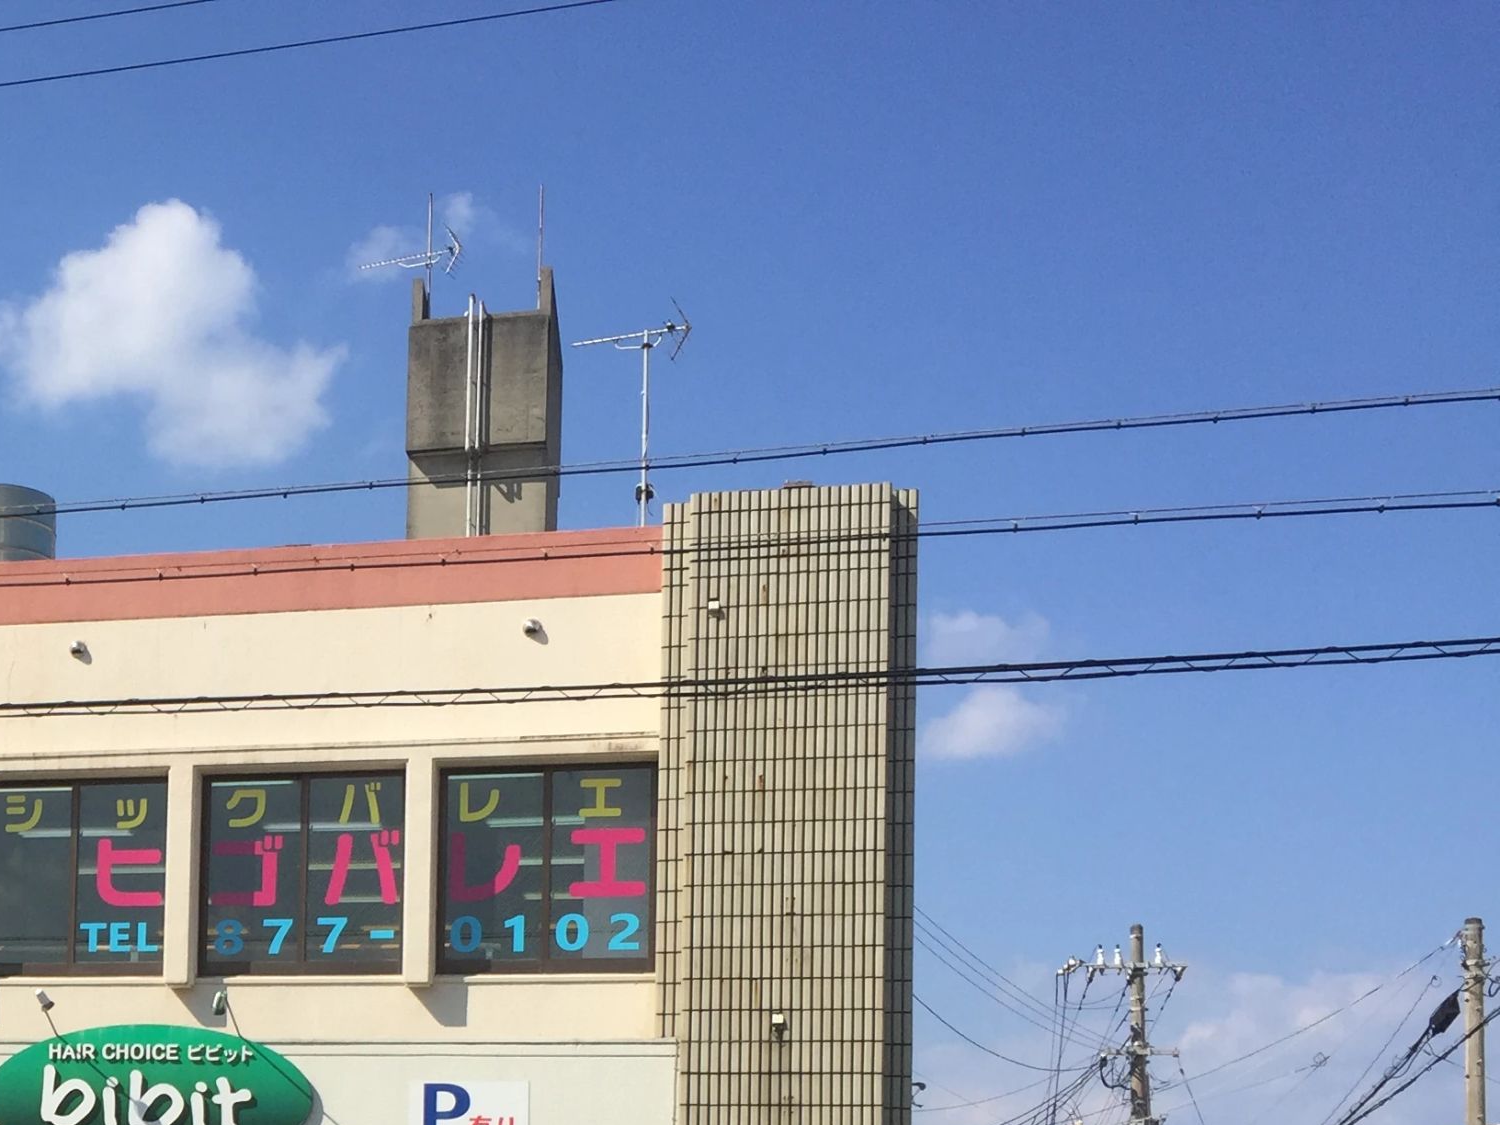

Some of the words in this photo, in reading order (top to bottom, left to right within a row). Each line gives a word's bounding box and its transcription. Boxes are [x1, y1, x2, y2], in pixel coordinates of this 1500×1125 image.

[79, 921, 160, 953] TEL
[48, 1043, 95, 1061] HAIR
[101, 1043, 179, 1061] CHOICE
[187, 1043, 253, 1063] ビビット
